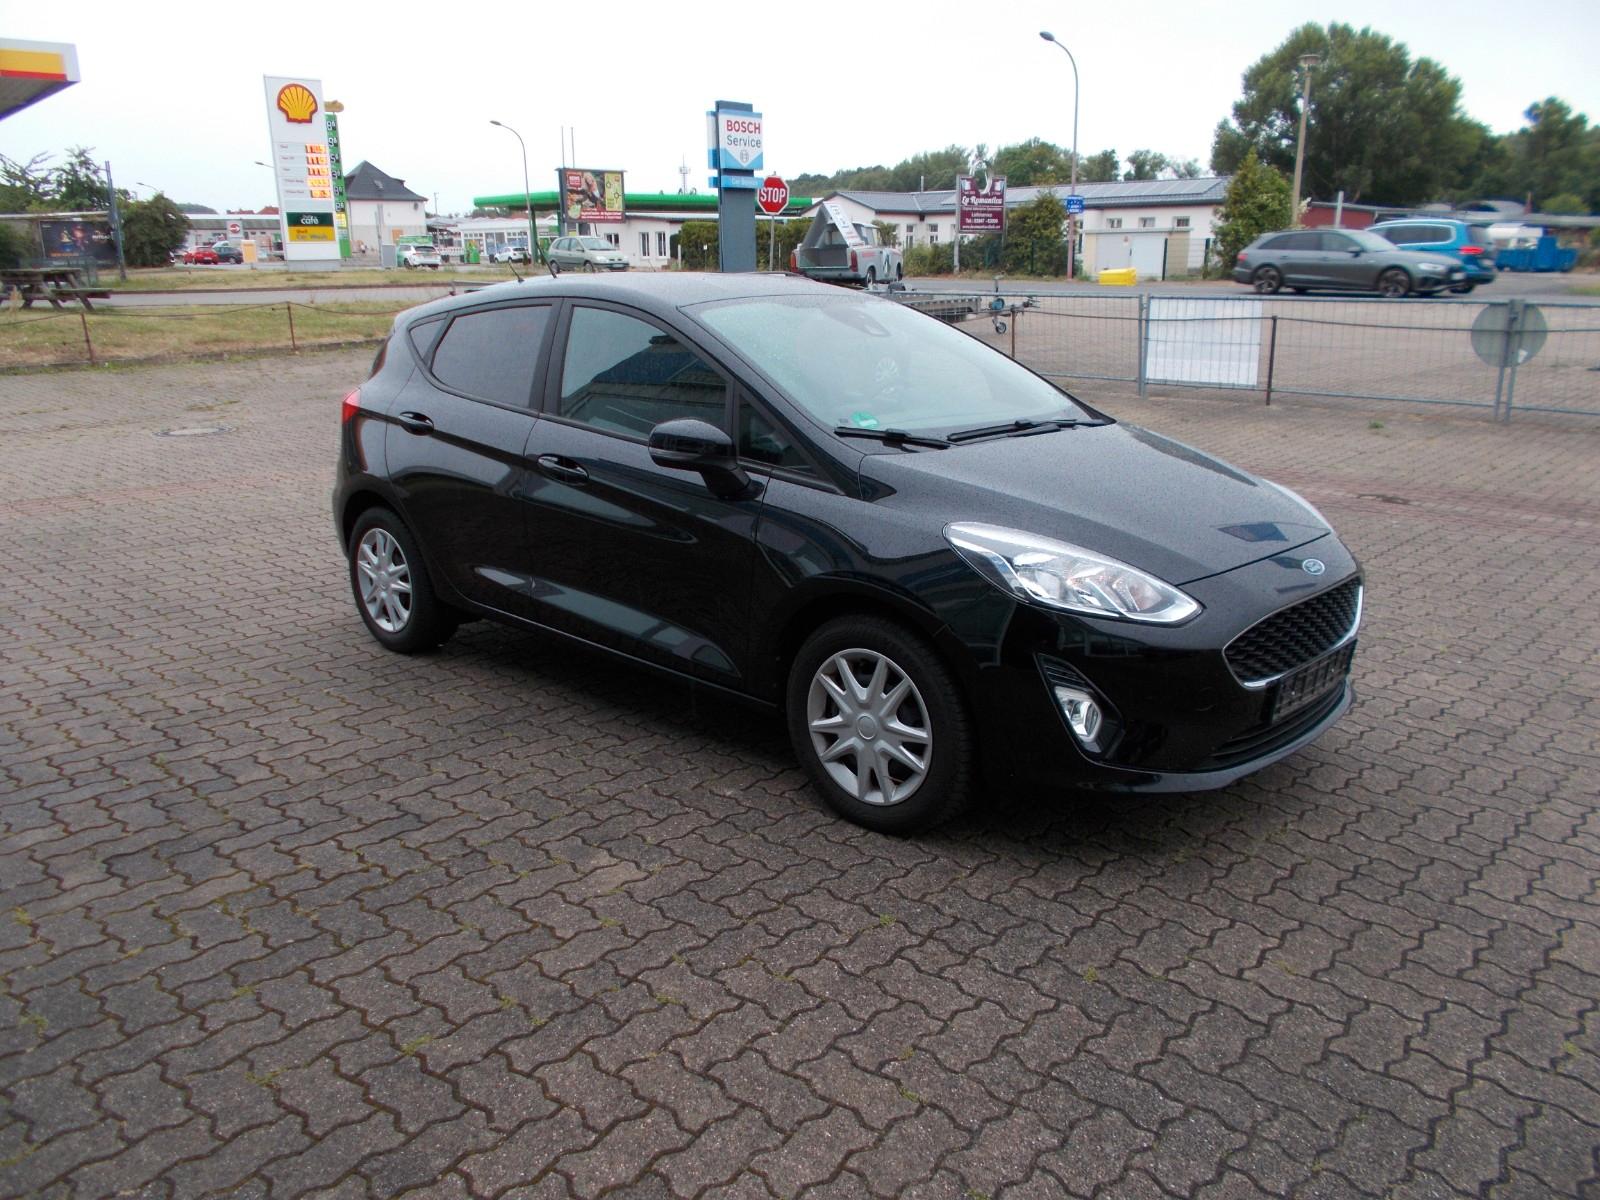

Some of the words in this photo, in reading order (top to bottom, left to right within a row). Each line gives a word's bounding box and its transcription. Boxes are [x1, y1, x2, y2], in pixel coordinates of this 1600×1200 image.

[726, 120, 761, 134] BOSCH
[726, 135, 762, 148] Service
[760, 187, 786, 203] STOP
